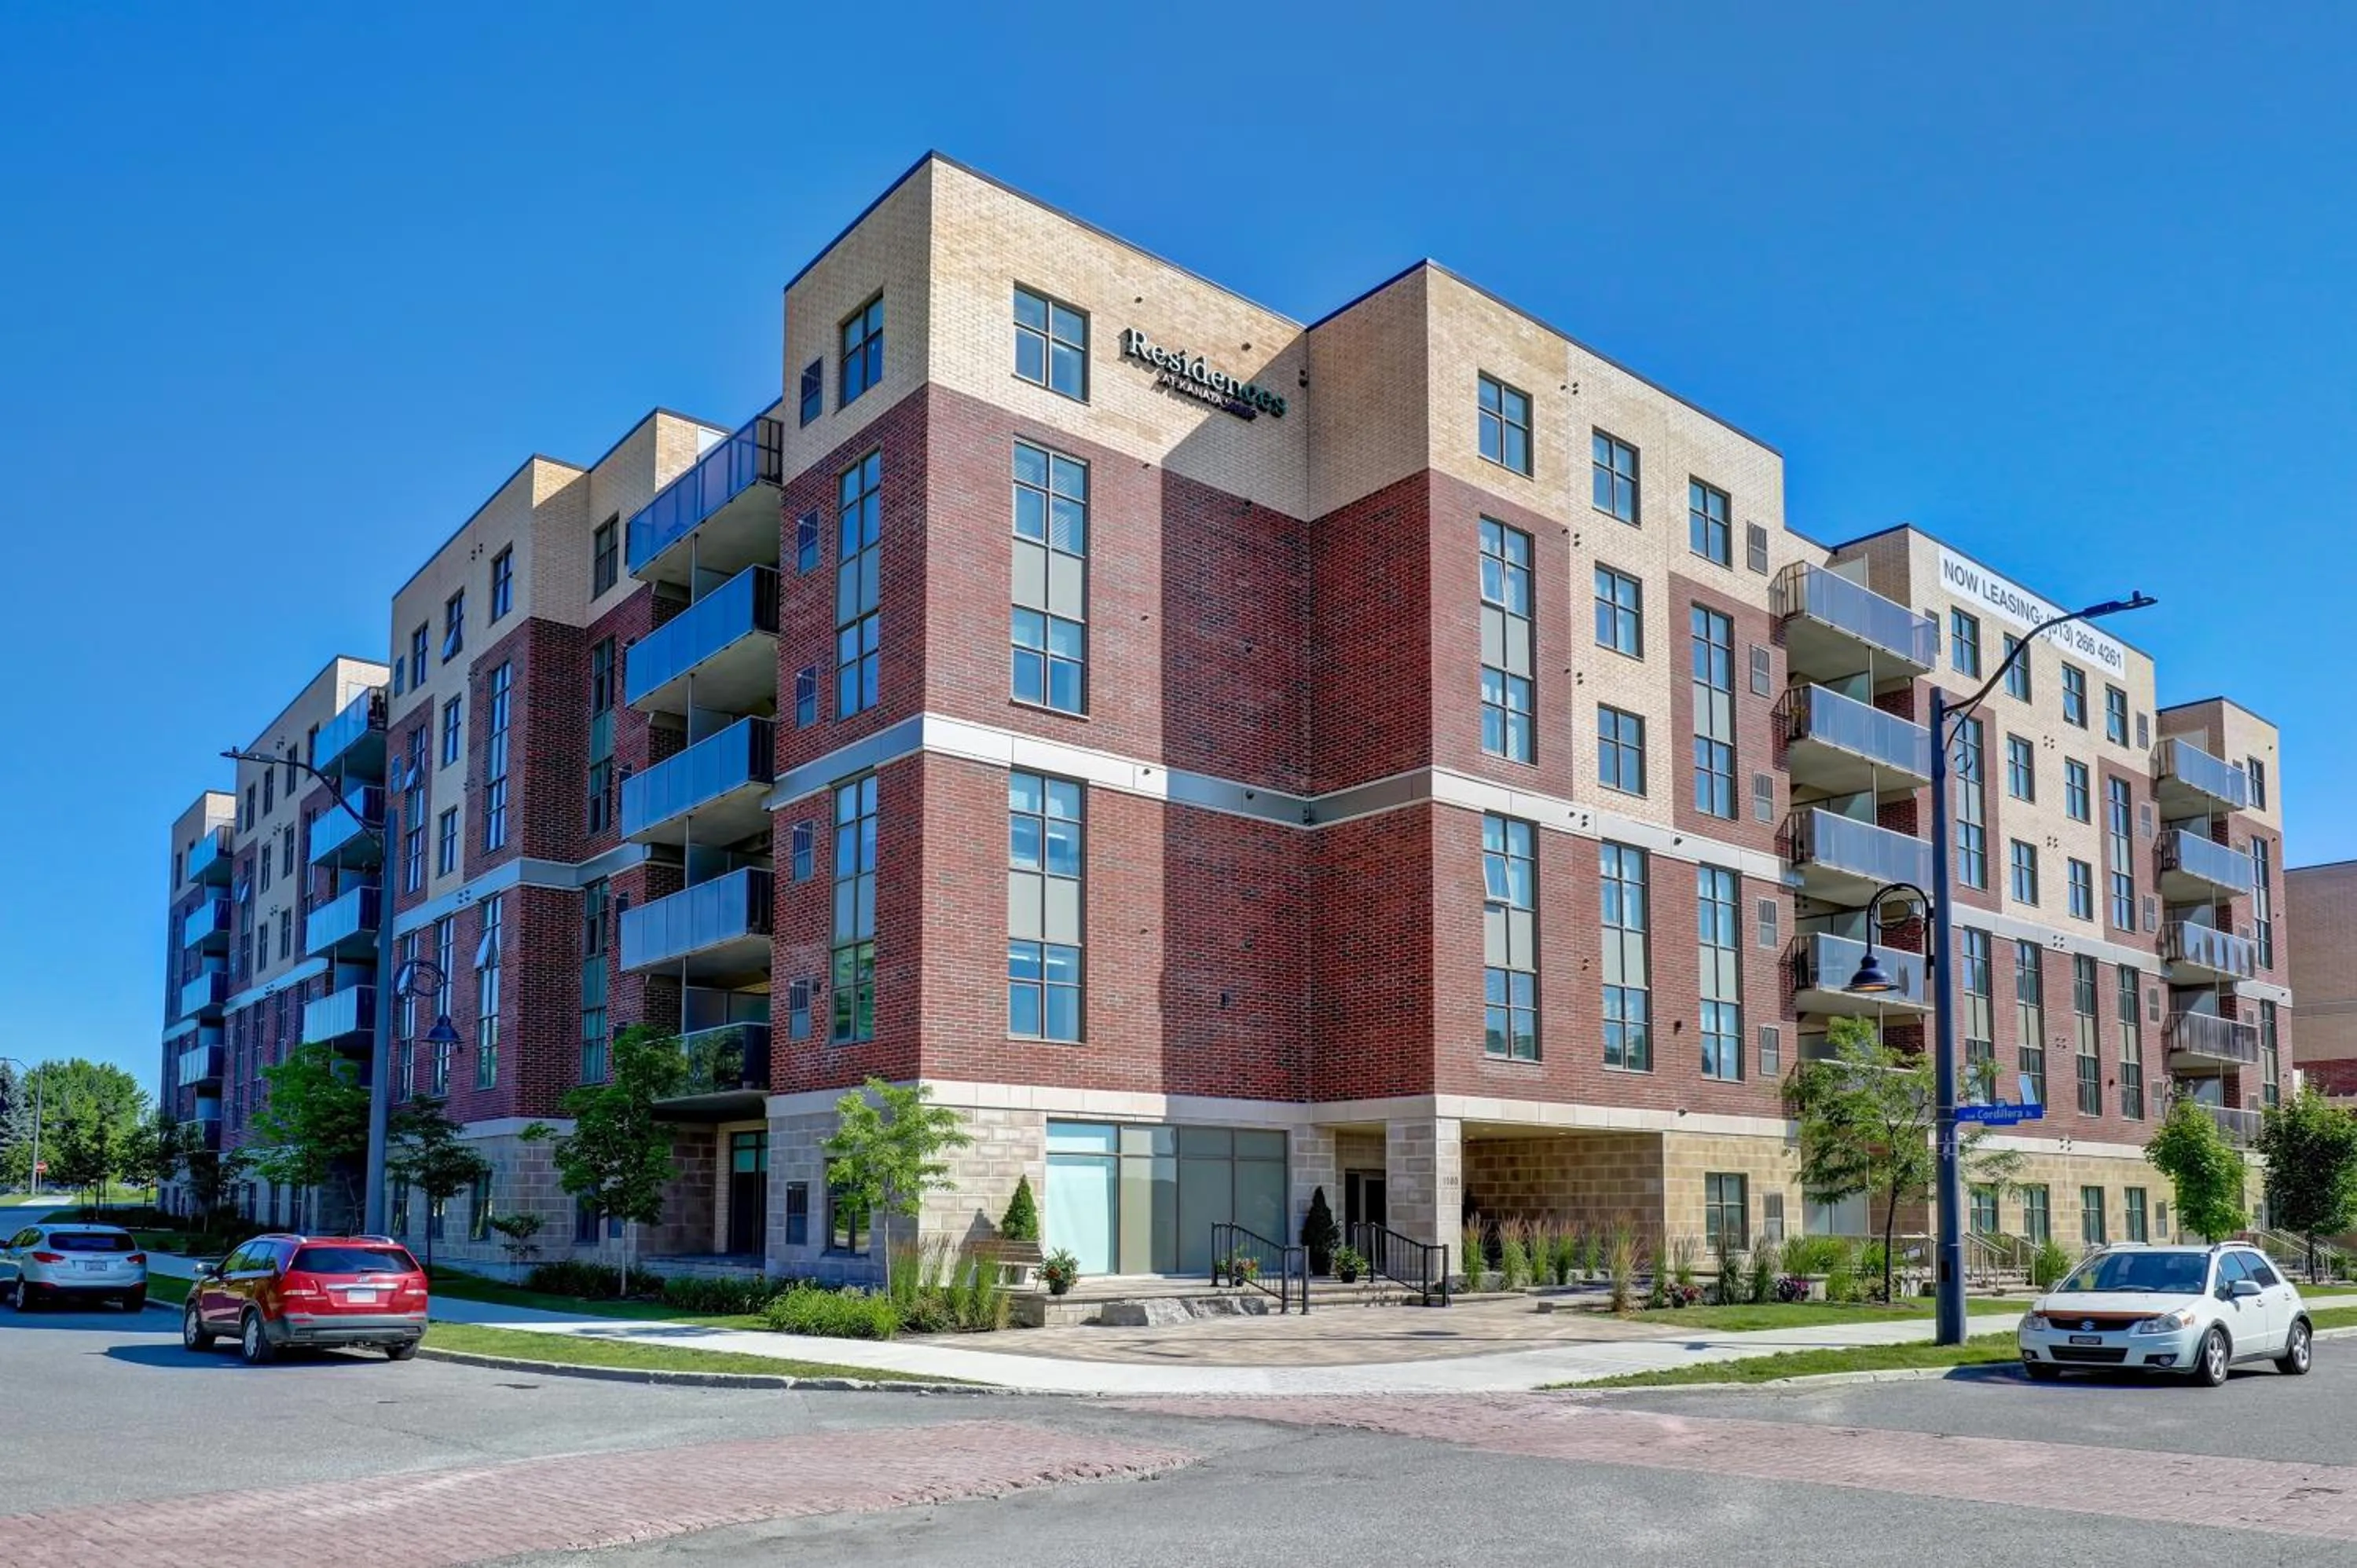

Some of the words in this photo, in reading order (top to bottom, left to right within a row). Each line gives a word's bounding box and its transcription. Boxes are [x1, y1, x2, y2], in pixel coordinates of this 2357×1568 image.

[1127, 328, 1288, 418] Residences
[1161, 373, 1176, 387] AT
[1178, 379, 1223, 405] KANATA
[1944, 559, 1979, 593] NOW
[2076, 630, 2095, 655] 266
[2098, 643, 2121, 669] 4261
[1978, 1107, 2023, 1119] Cordillera
